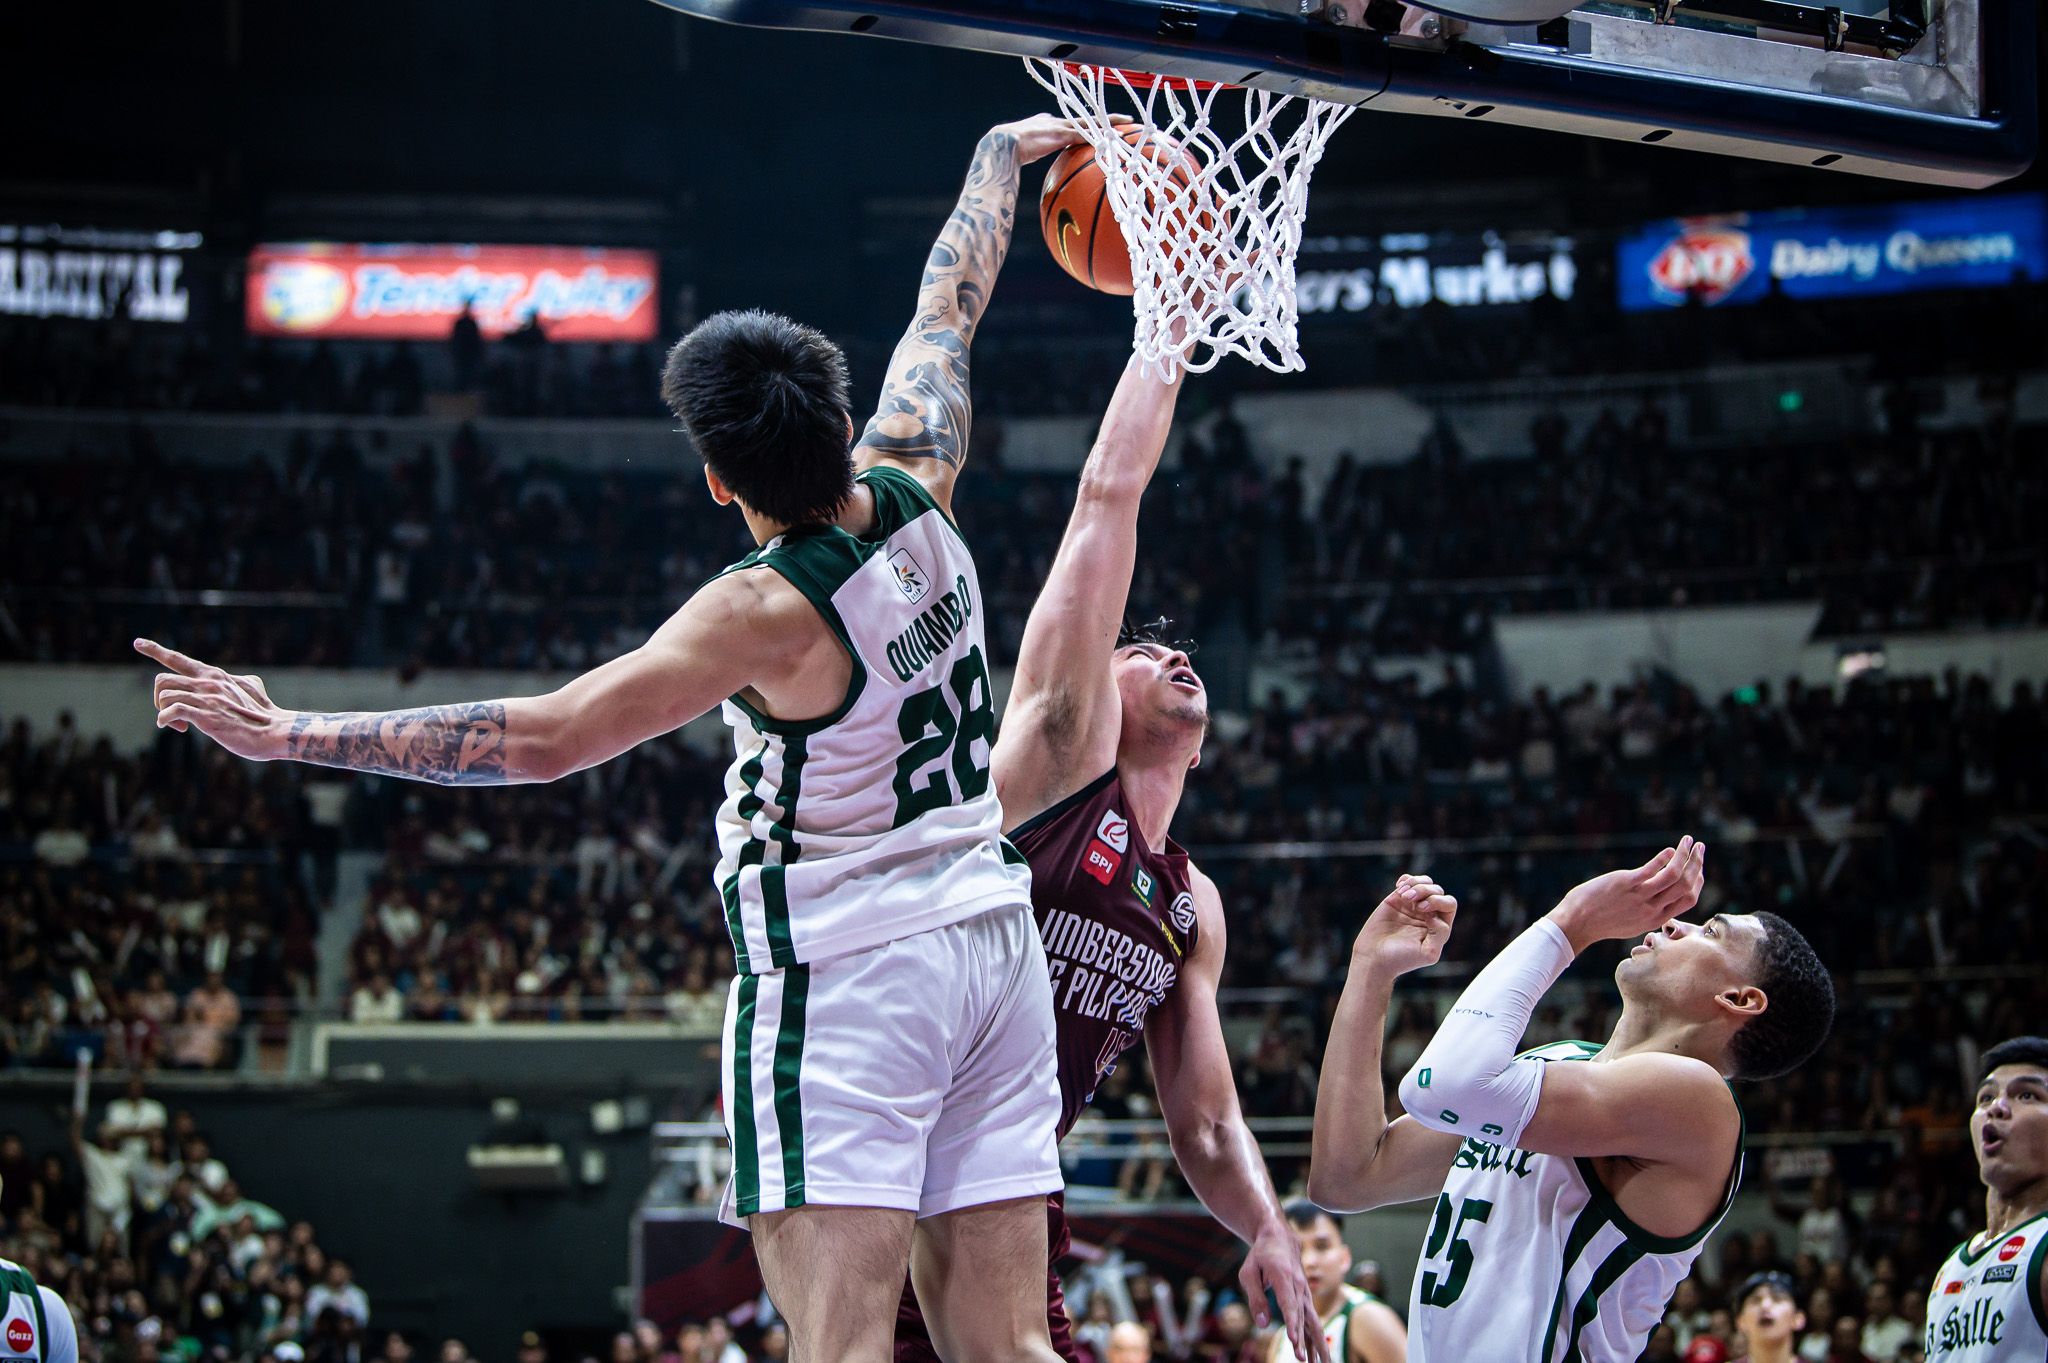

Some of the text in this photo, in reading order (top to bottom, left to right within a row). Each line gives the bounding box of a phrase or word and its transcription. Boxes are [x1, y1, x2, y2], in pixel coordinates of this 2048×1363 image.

[1378, 248, 1577, 306] Market
[1771, 230, 2014, 279] Dairy Queen
[352, 263, 526, 318] Tender
[500, 265, 652, 325] Juicy
[886, 574, 971, 683] QUIAMBO
[892, 644, 994, 830] 28
[1089, 849, 1113, 874] BPI
[8, 1329, 32, 1341] Gazz
[1938, 1296, 2004, 1353] Salle
